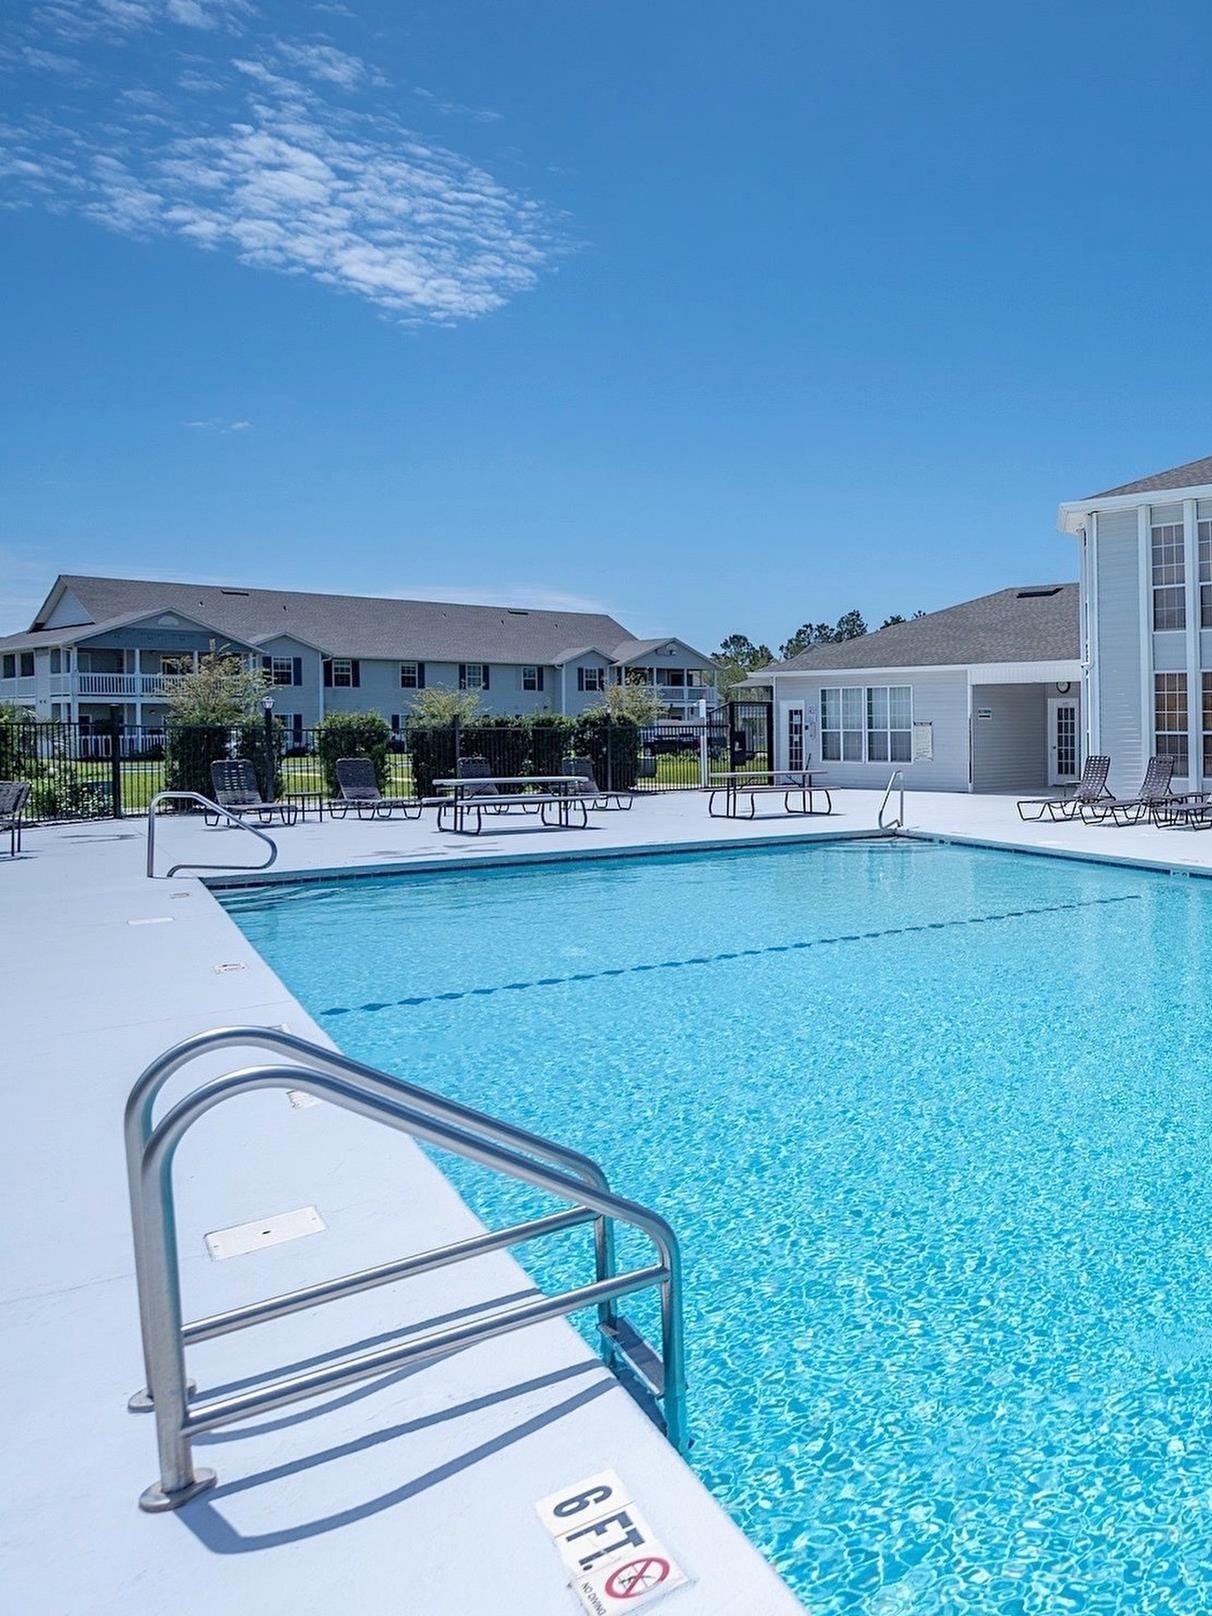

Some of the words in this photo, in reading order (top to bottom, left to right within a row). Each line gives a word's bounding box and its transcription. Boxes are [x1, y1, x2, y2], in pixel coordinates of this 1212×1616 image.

[553, 1485, 613, 1517] 6
[565, 1510, 646, 1571] FT.
[581, 1582, 593, 1593] NO
